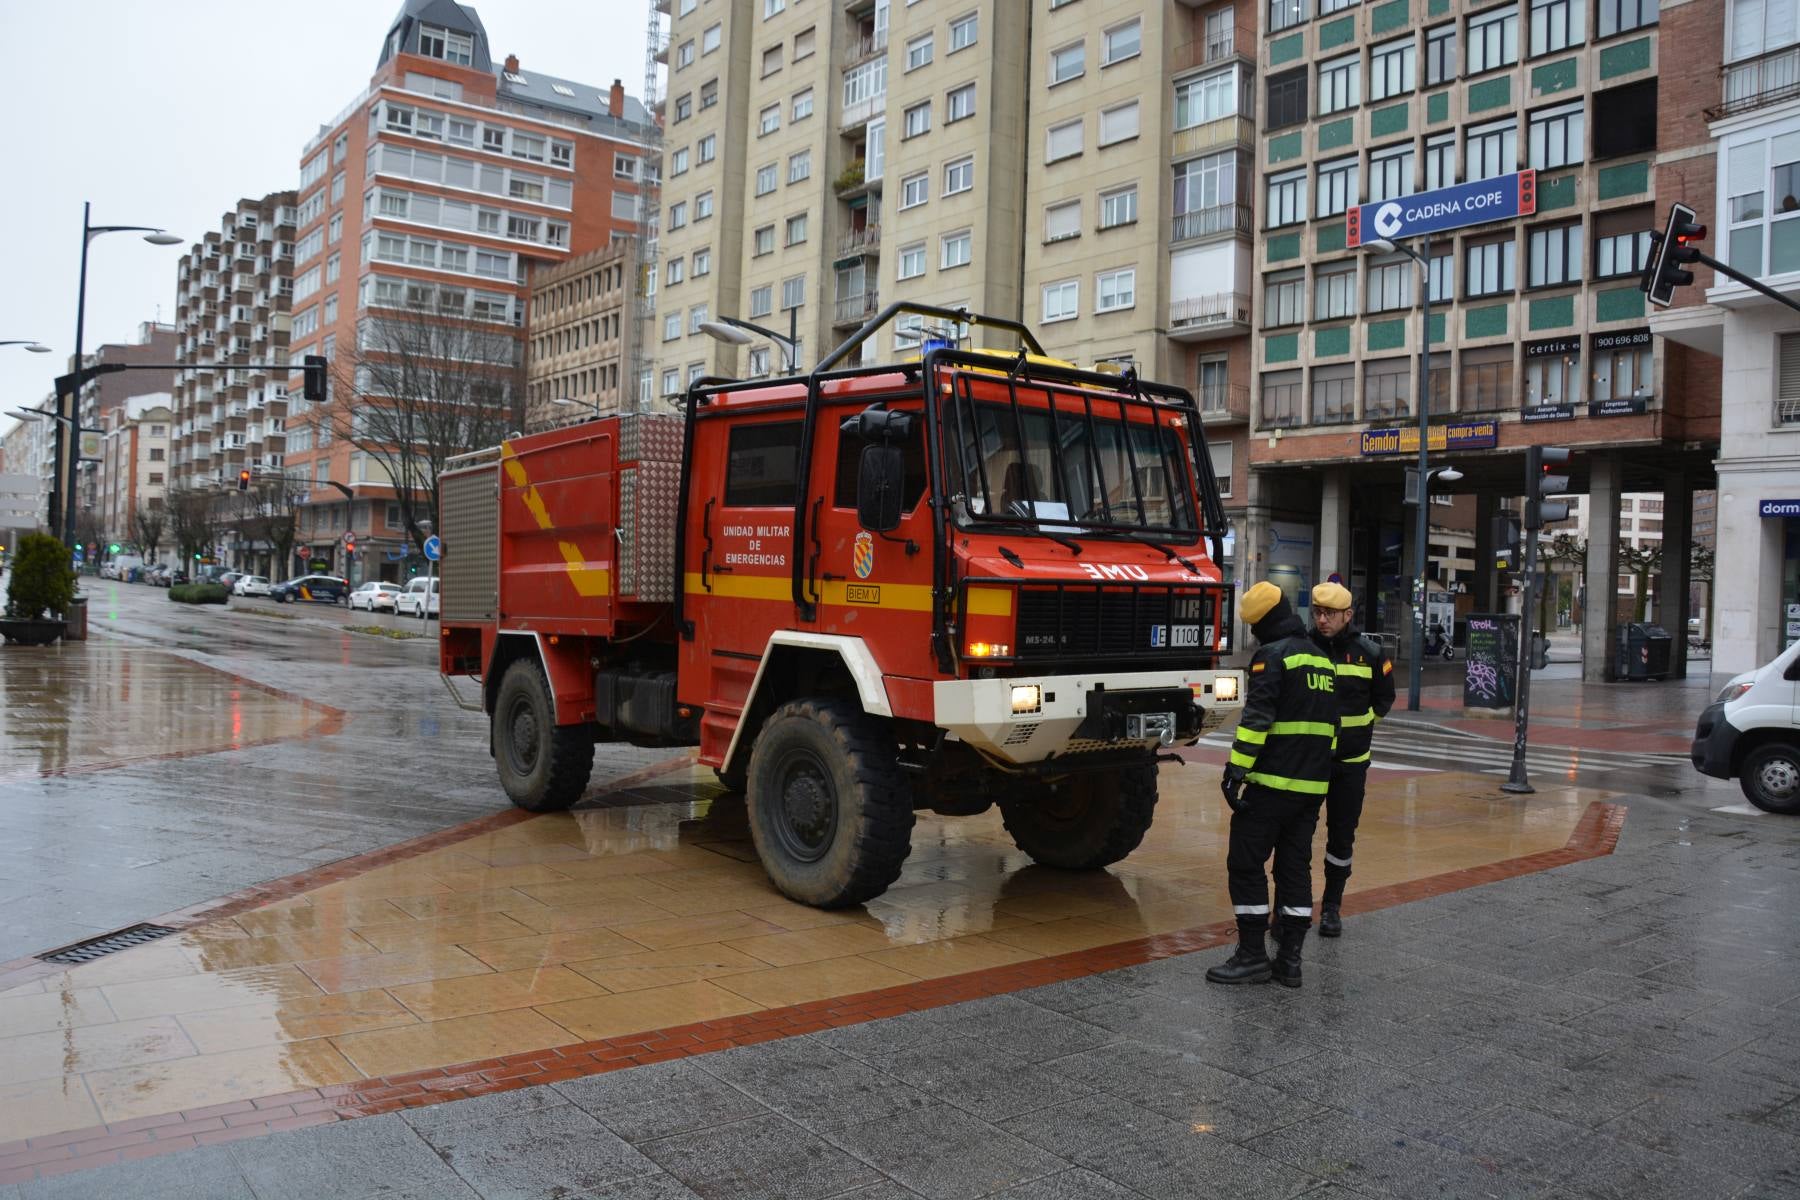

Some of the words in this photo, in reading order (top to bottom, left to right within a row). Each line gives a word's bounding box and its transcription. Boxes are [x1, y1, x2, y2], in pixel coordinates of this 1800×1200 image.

[1406, 201, 1461, 222] CADENA
[1465, 191, 1503, 210] COPE
[1598, 338, 1613, 347] 900
[1615, 336, 1631, 345] 696
[1633, 333, 1649, 343] 808
[1362, 432, 1399, 453] Gemdor
[1447, 425, 1493, 440] compra-venta
[723, 526, 753, 537] UNIDAD
[757, 526, 790, 537] MILITAR
[749, 540, 761, 551] DE
[725, 553, 785, 566] EMERGENCIAS
[848, 588, 870, 601] BIEM
